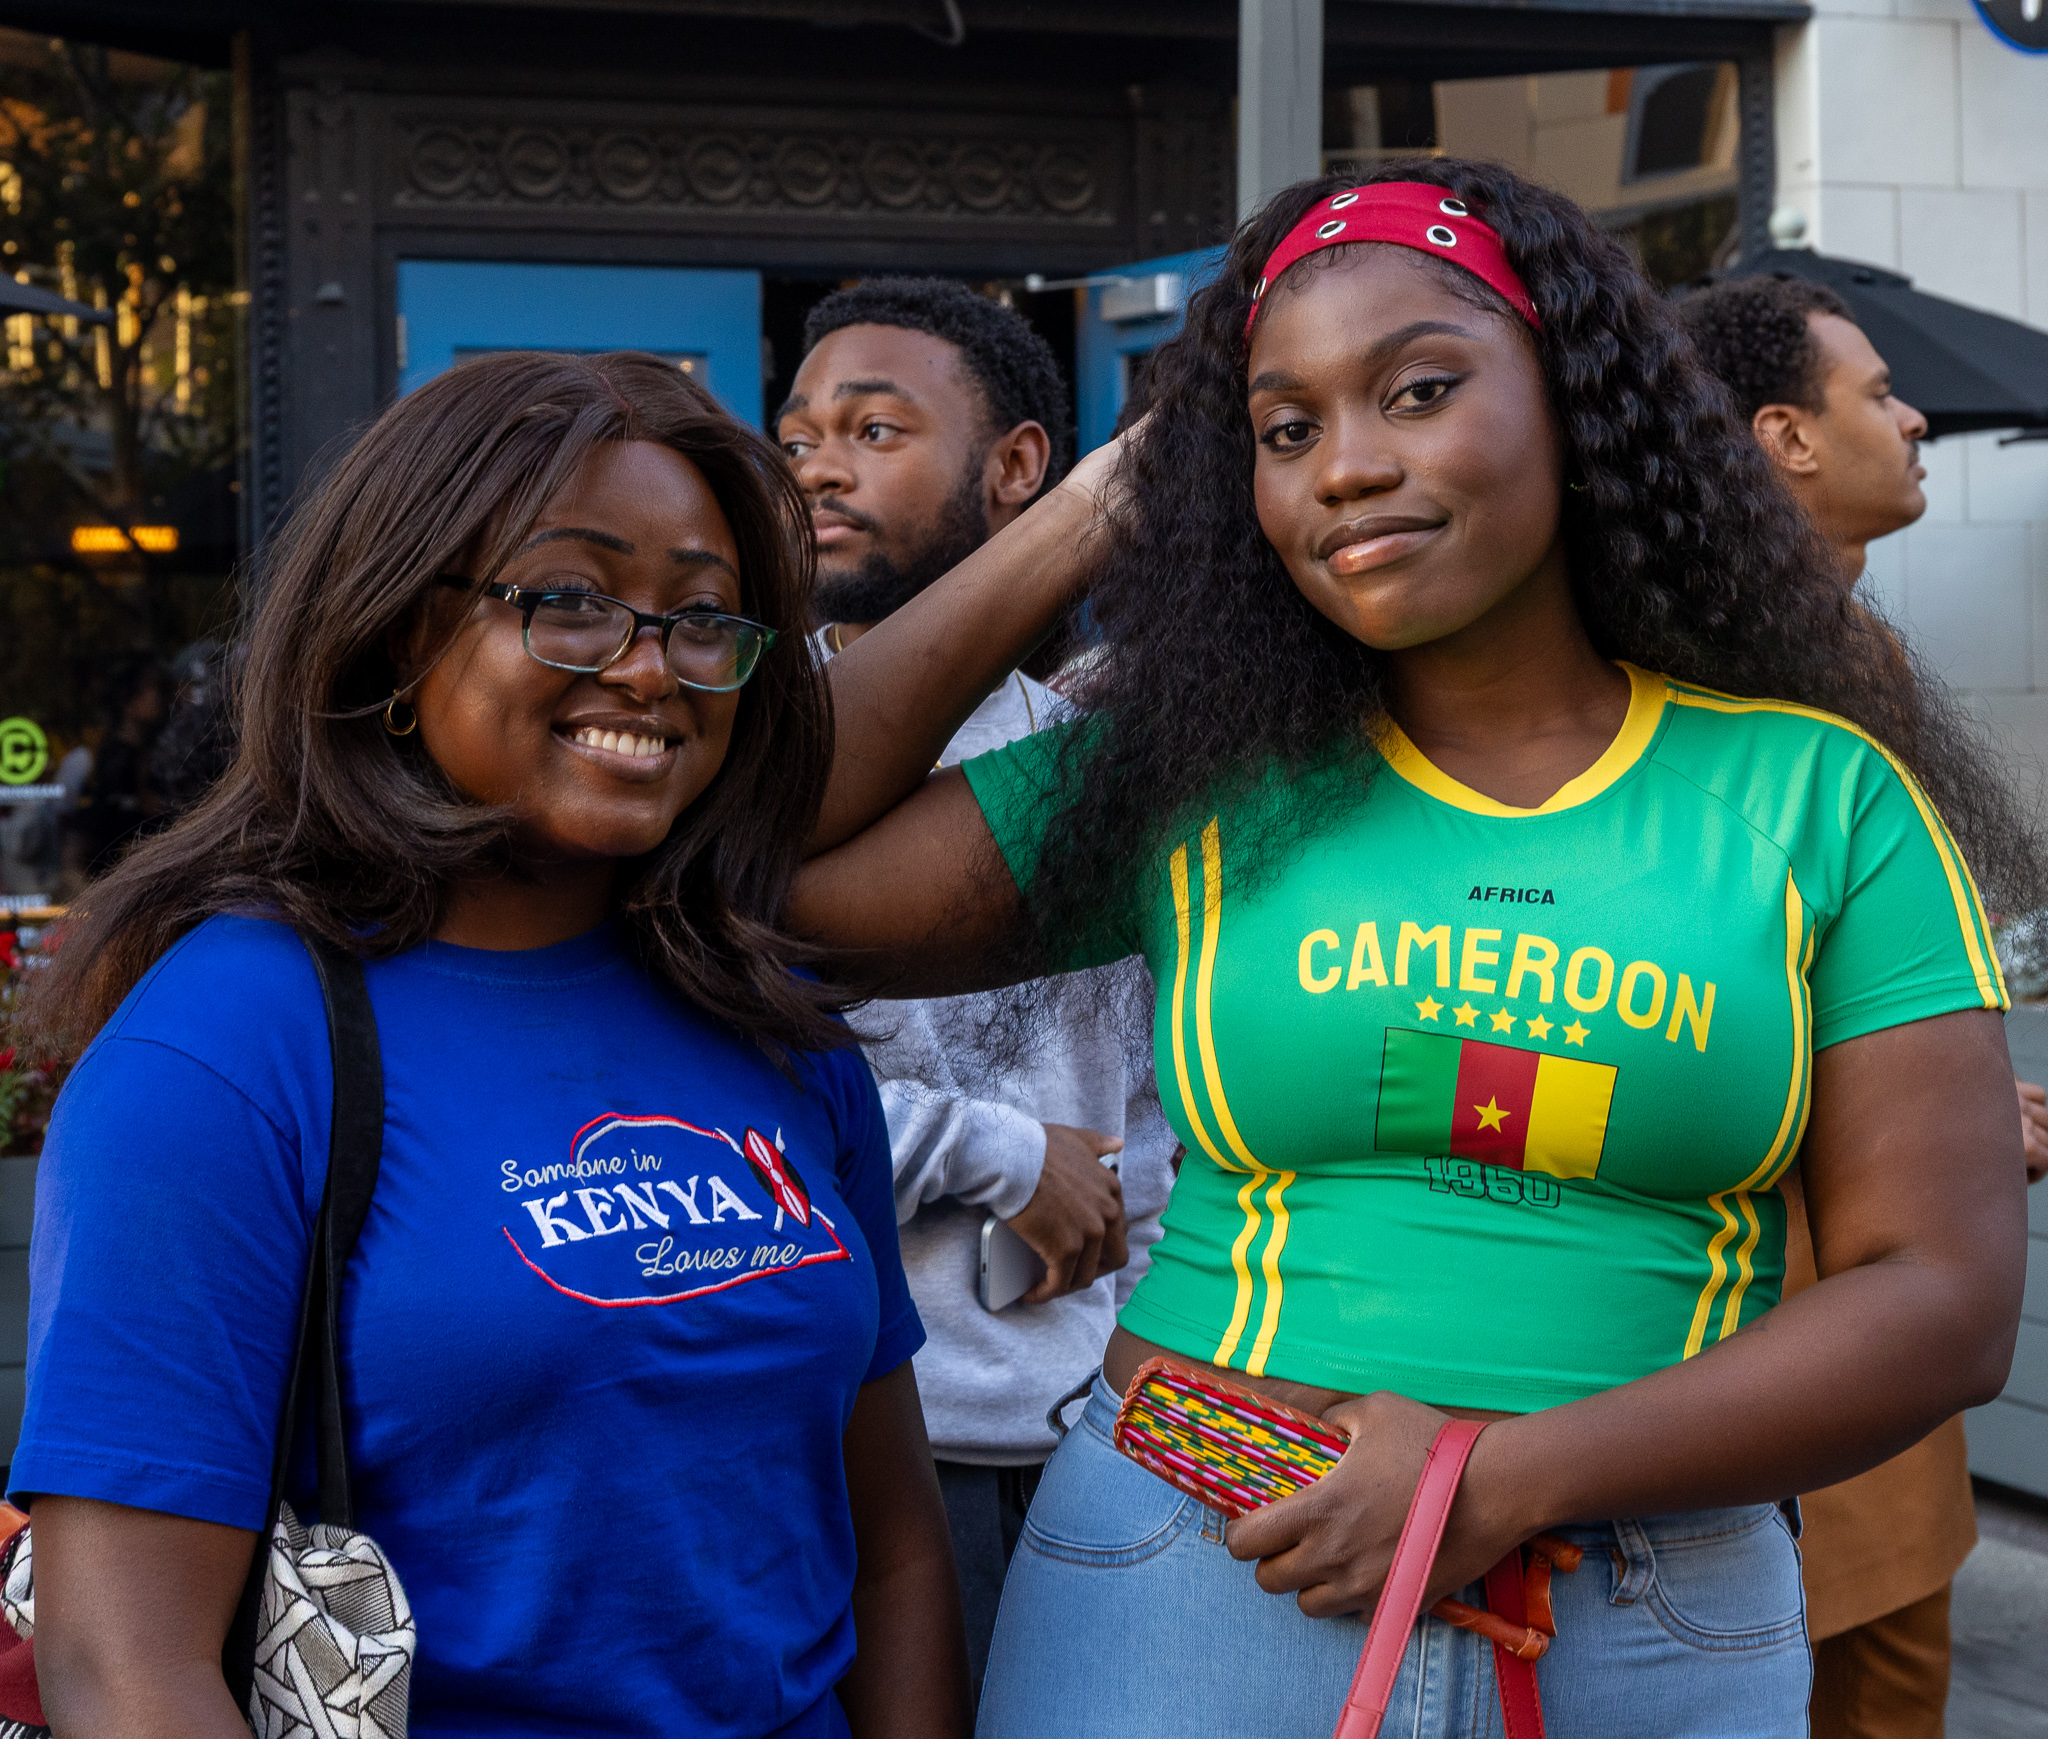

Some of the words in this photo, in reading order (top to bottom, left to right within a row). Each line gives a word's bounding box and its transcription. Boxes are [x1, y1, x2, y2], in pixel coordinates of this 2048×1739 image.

[1467, 885, 1555, 905] AFRICA
[1298, 921, 1717, 1053] CAMEROON
[501, 1159, 627, 1193] Someone
[631, 1148, 662, 1172] in
[1424, 1156, 1561, 1209] 1960
[521, 1174, 763, 1249] KENYA
[635, 1235, 747, 1277] Loves
[750, 1243, 803, 1268] me
